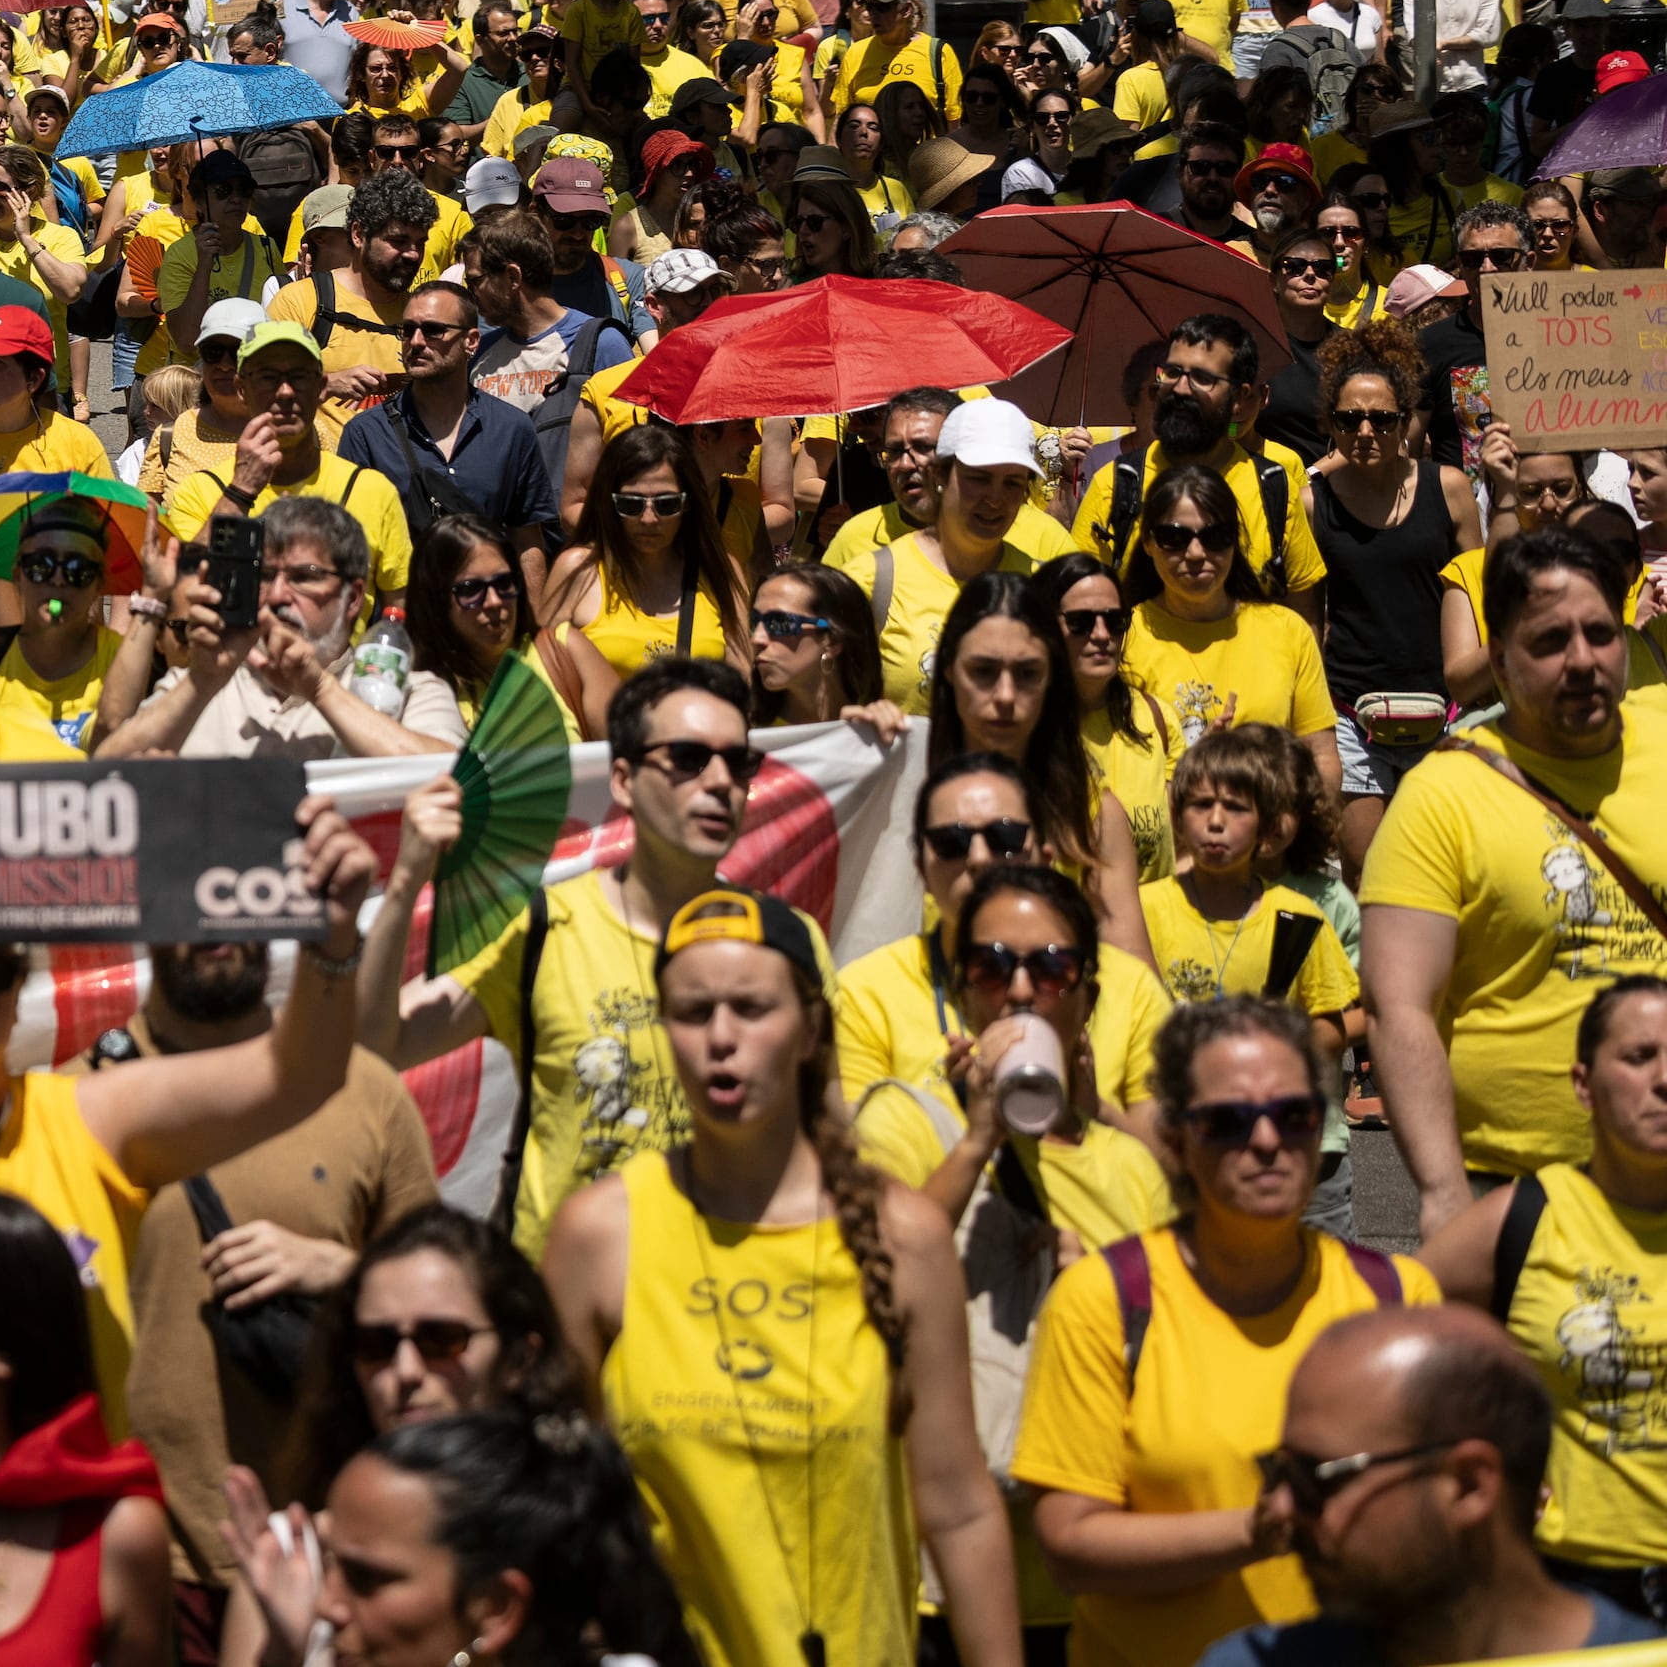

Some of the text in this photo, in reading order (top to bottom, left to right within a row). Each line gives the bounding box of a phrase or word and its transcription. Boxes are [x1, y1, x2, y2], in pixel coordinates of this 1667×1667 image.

[880, 63, 914, 75] SOS
[1560, 284, 1617, 317] poder
[1506, 316, 1613, 347] a TOTS
[516, 370, 560, 396] YOR
[1505, 356, 1632, 392] els meus
[685, 1278, 813, 1321] SOS
